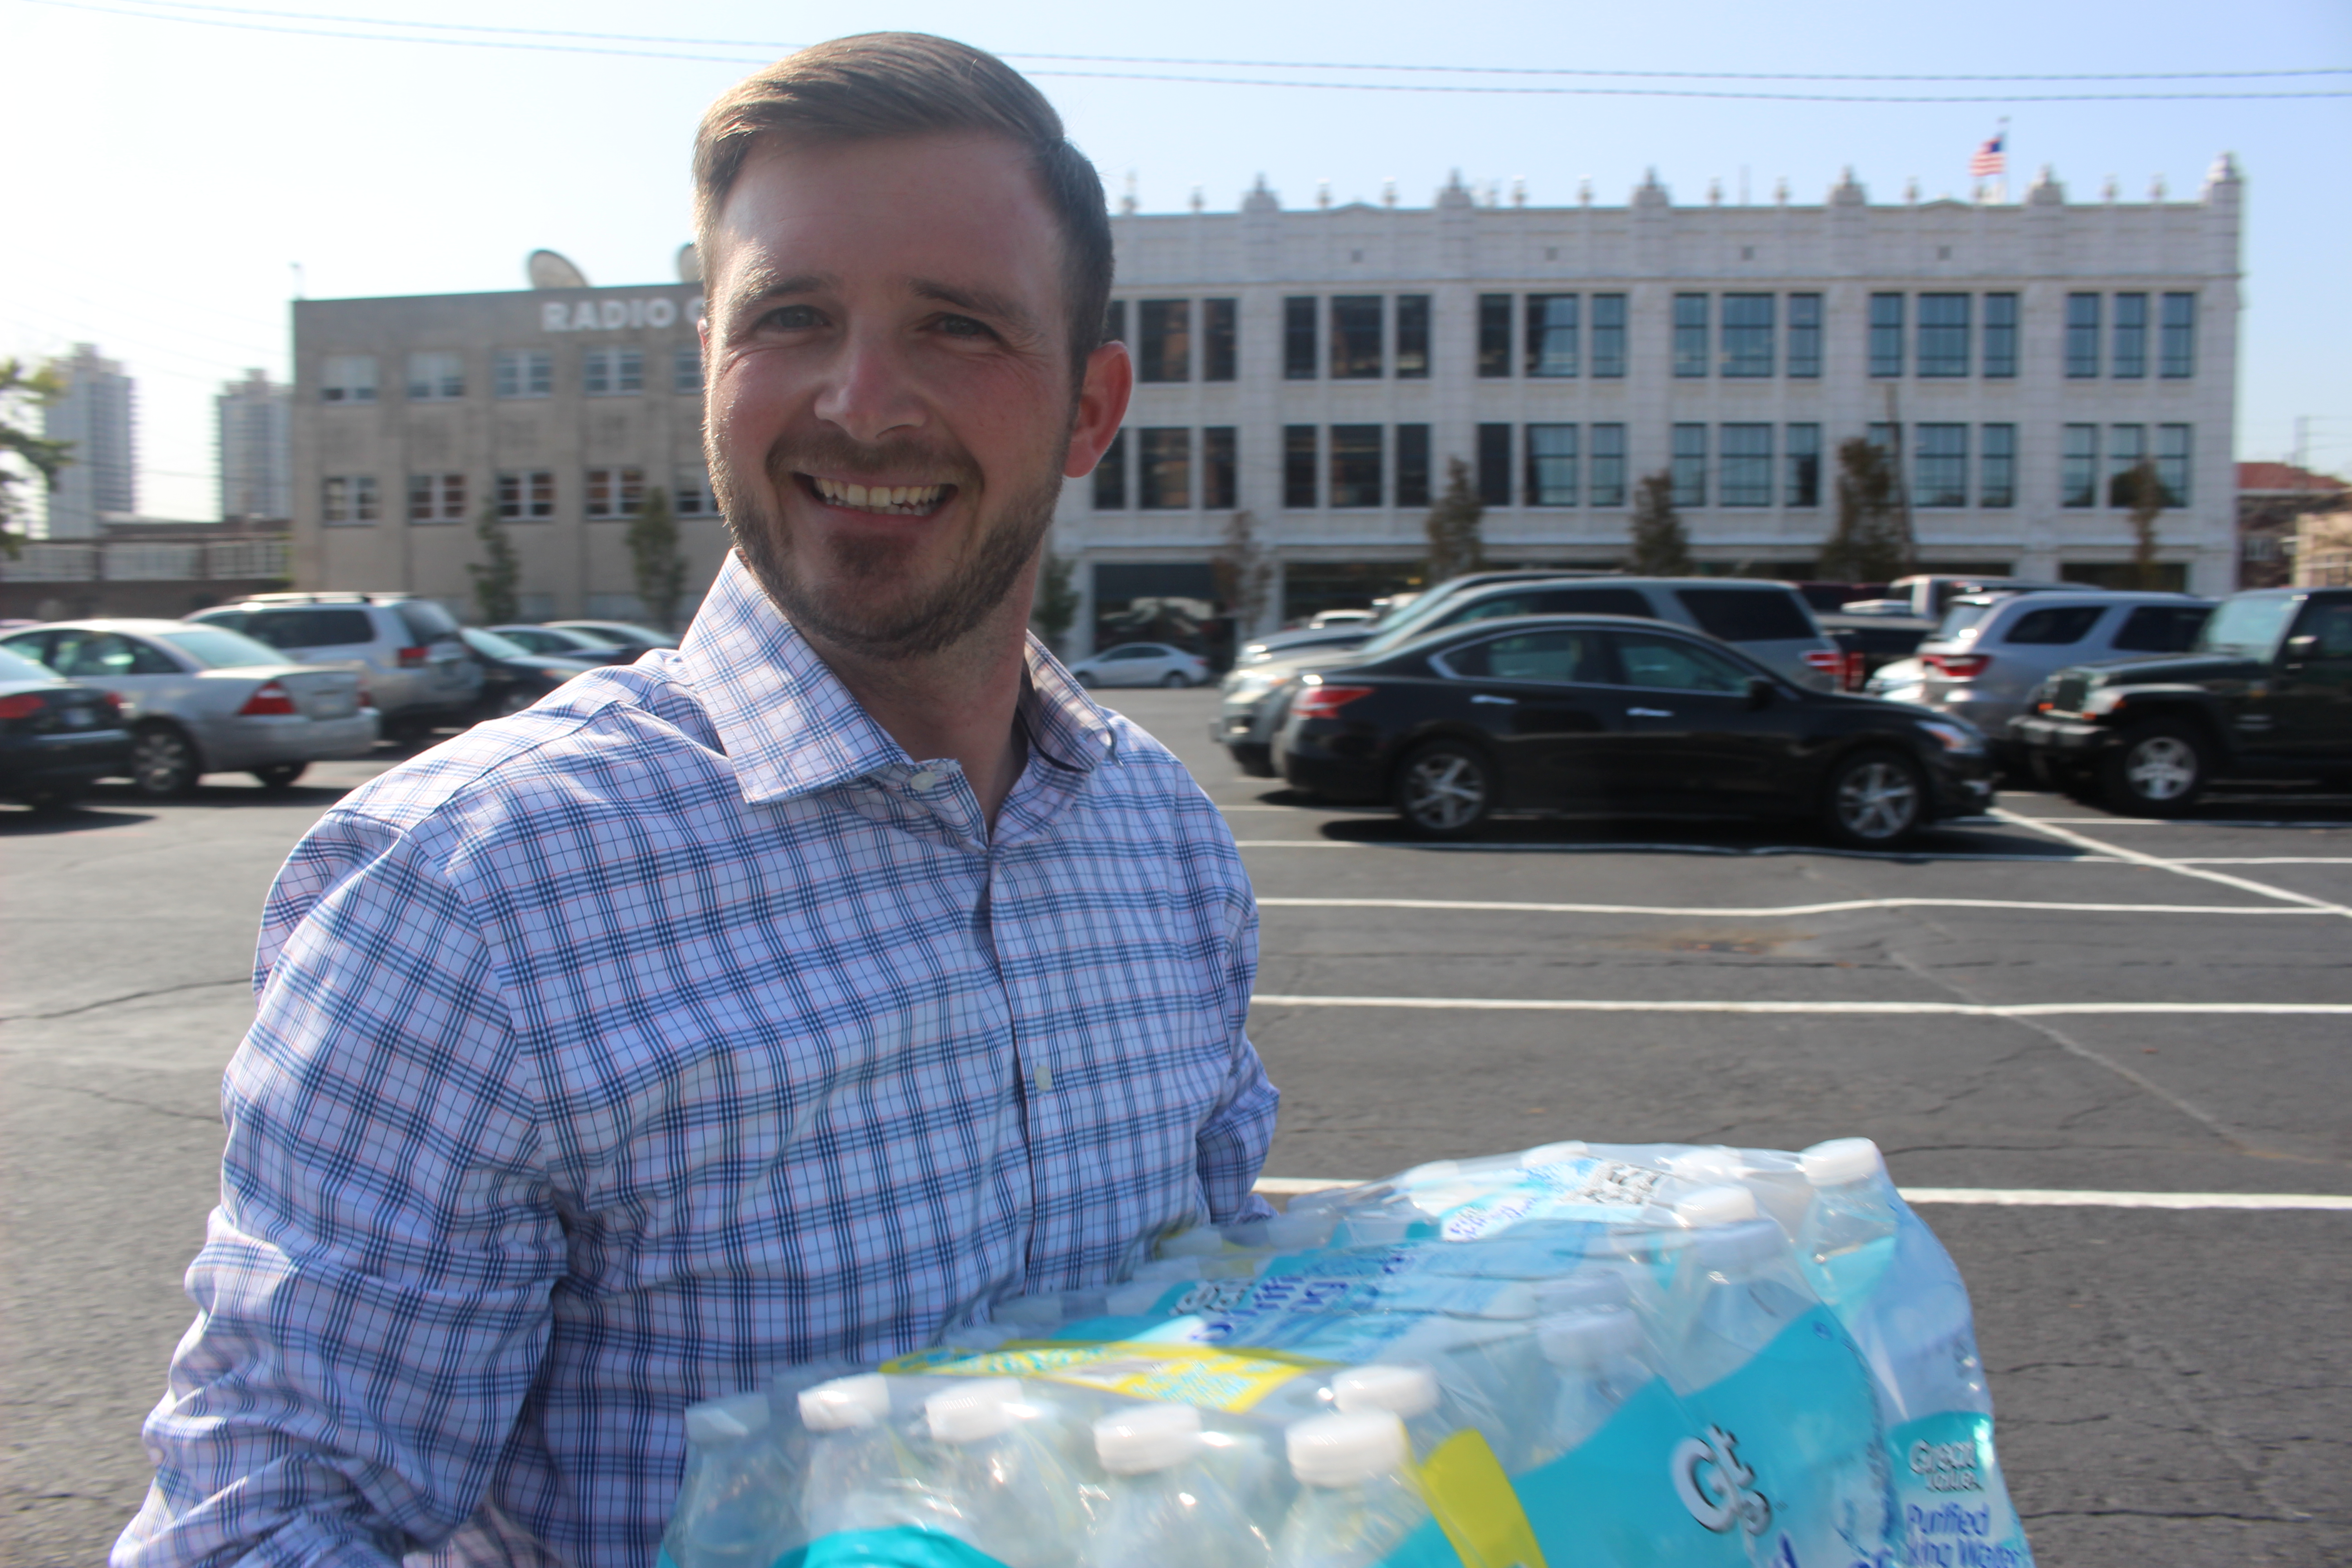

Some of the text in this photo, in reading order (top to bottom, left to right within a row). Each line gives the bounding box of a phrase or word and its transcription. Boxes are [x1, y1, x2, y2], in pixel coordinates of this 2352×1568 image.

[542, 298, 677, 332] RADIO
[1909, 1438, 1977, 1475] Great
[1907, 1502, 1990, 1538] Purified
